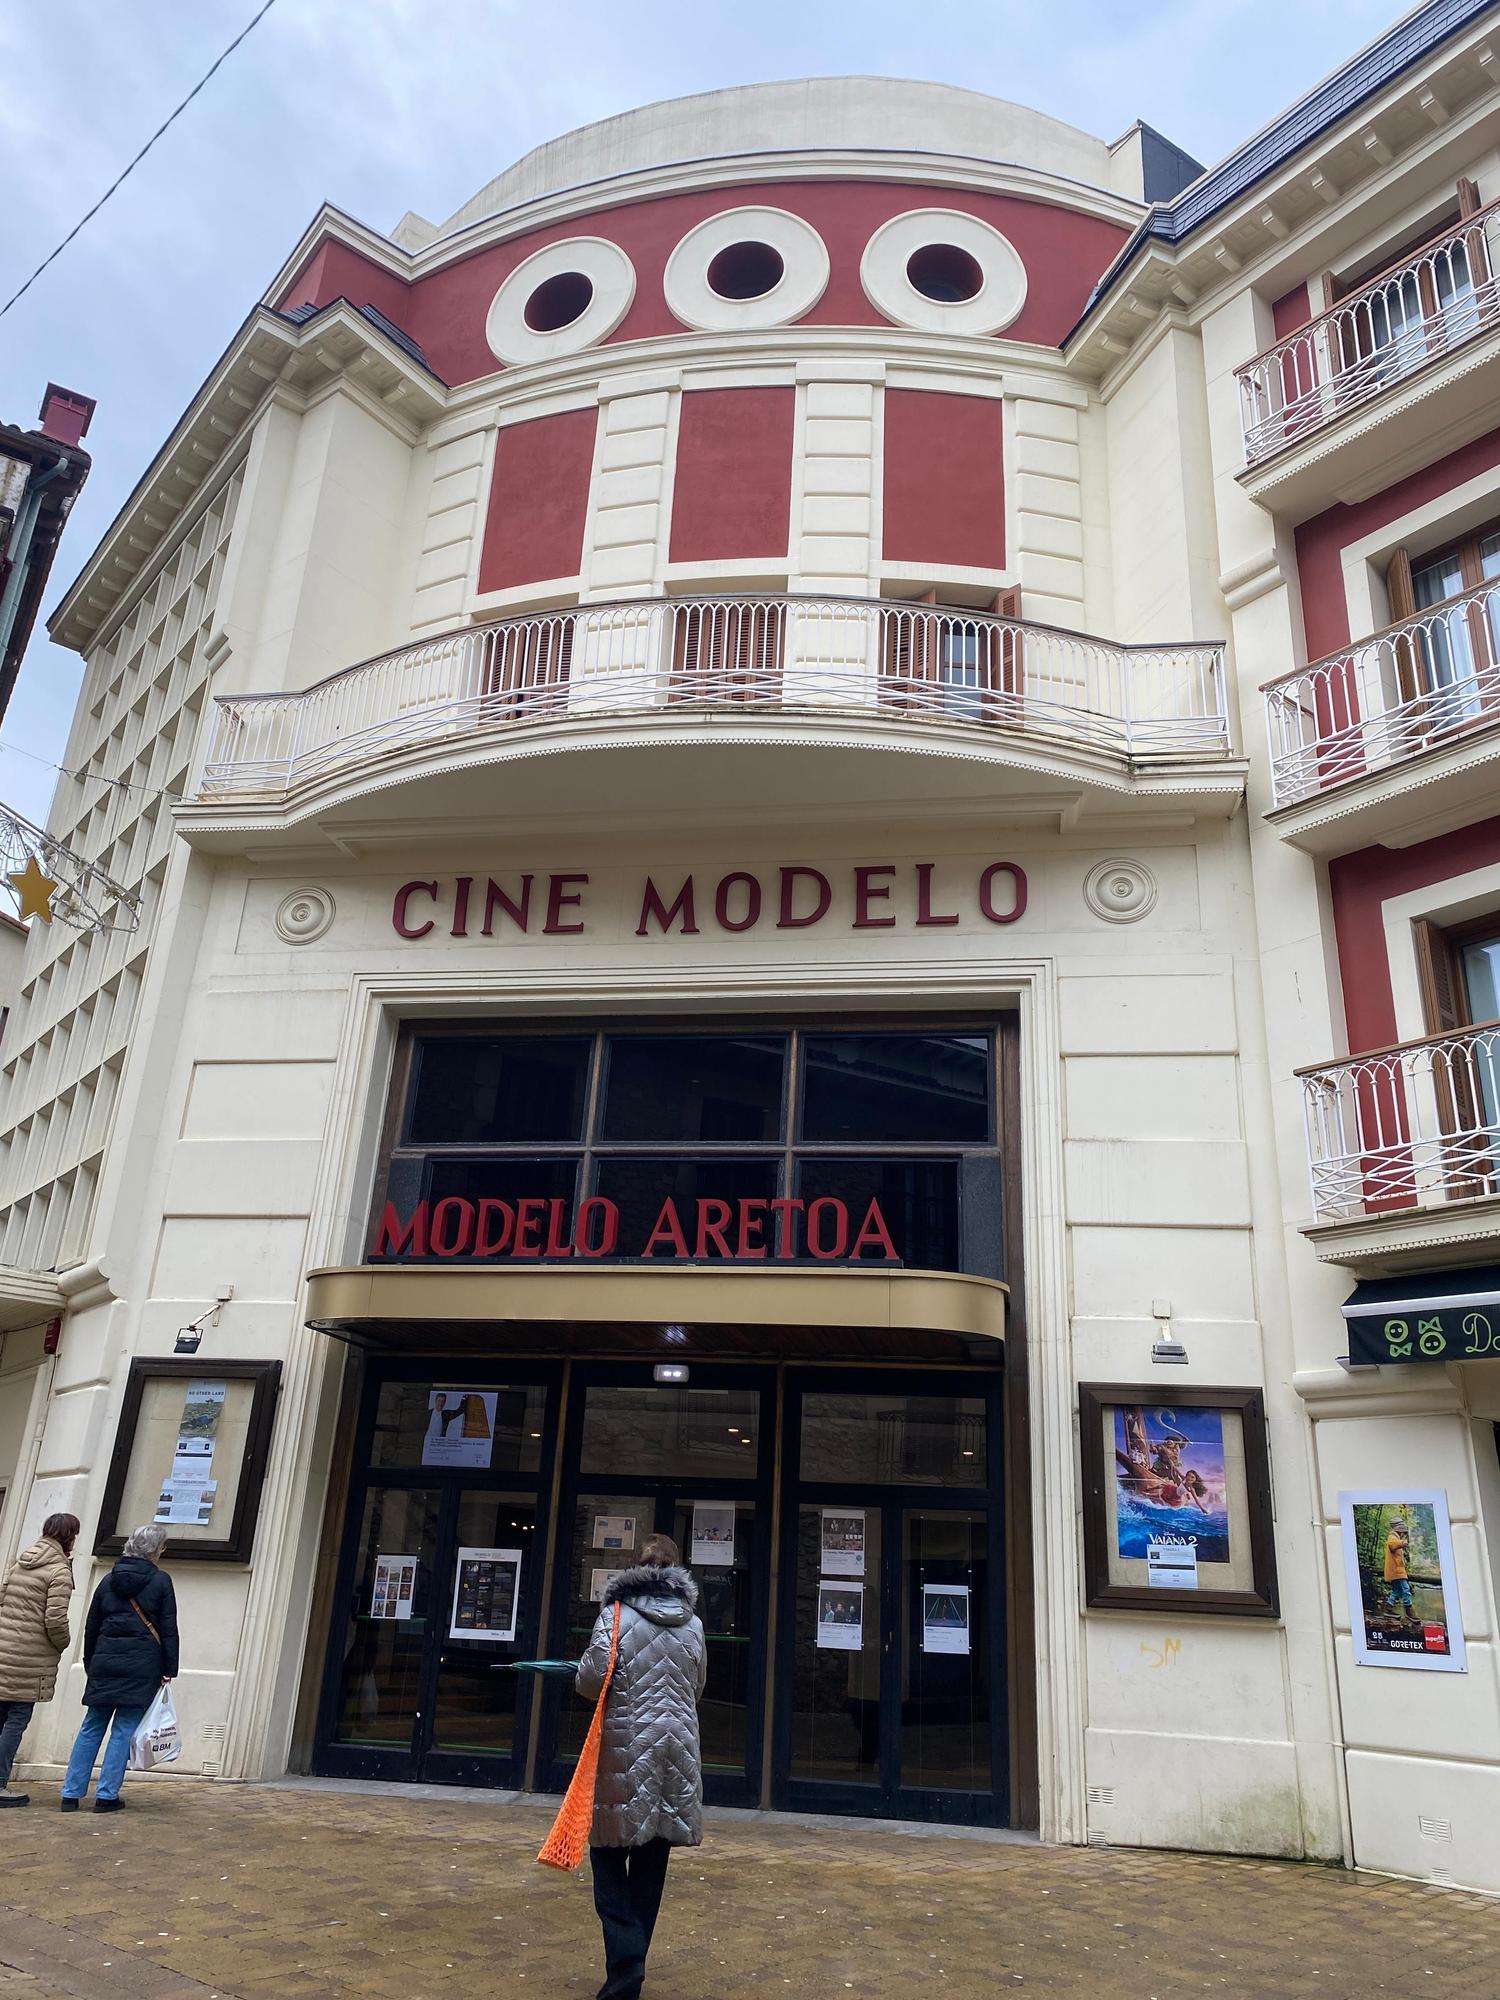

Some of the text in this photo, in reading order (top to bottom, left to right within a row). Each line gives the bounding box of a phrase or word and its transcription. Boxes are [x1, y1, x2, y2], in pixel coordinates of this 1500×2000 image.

[392, 861, 1029, 939] CINE MODELO
[374, 1195, 900, 1260] MODELO ARETOA
[1149, 1533, 1199, 1547] VAIANA 2
